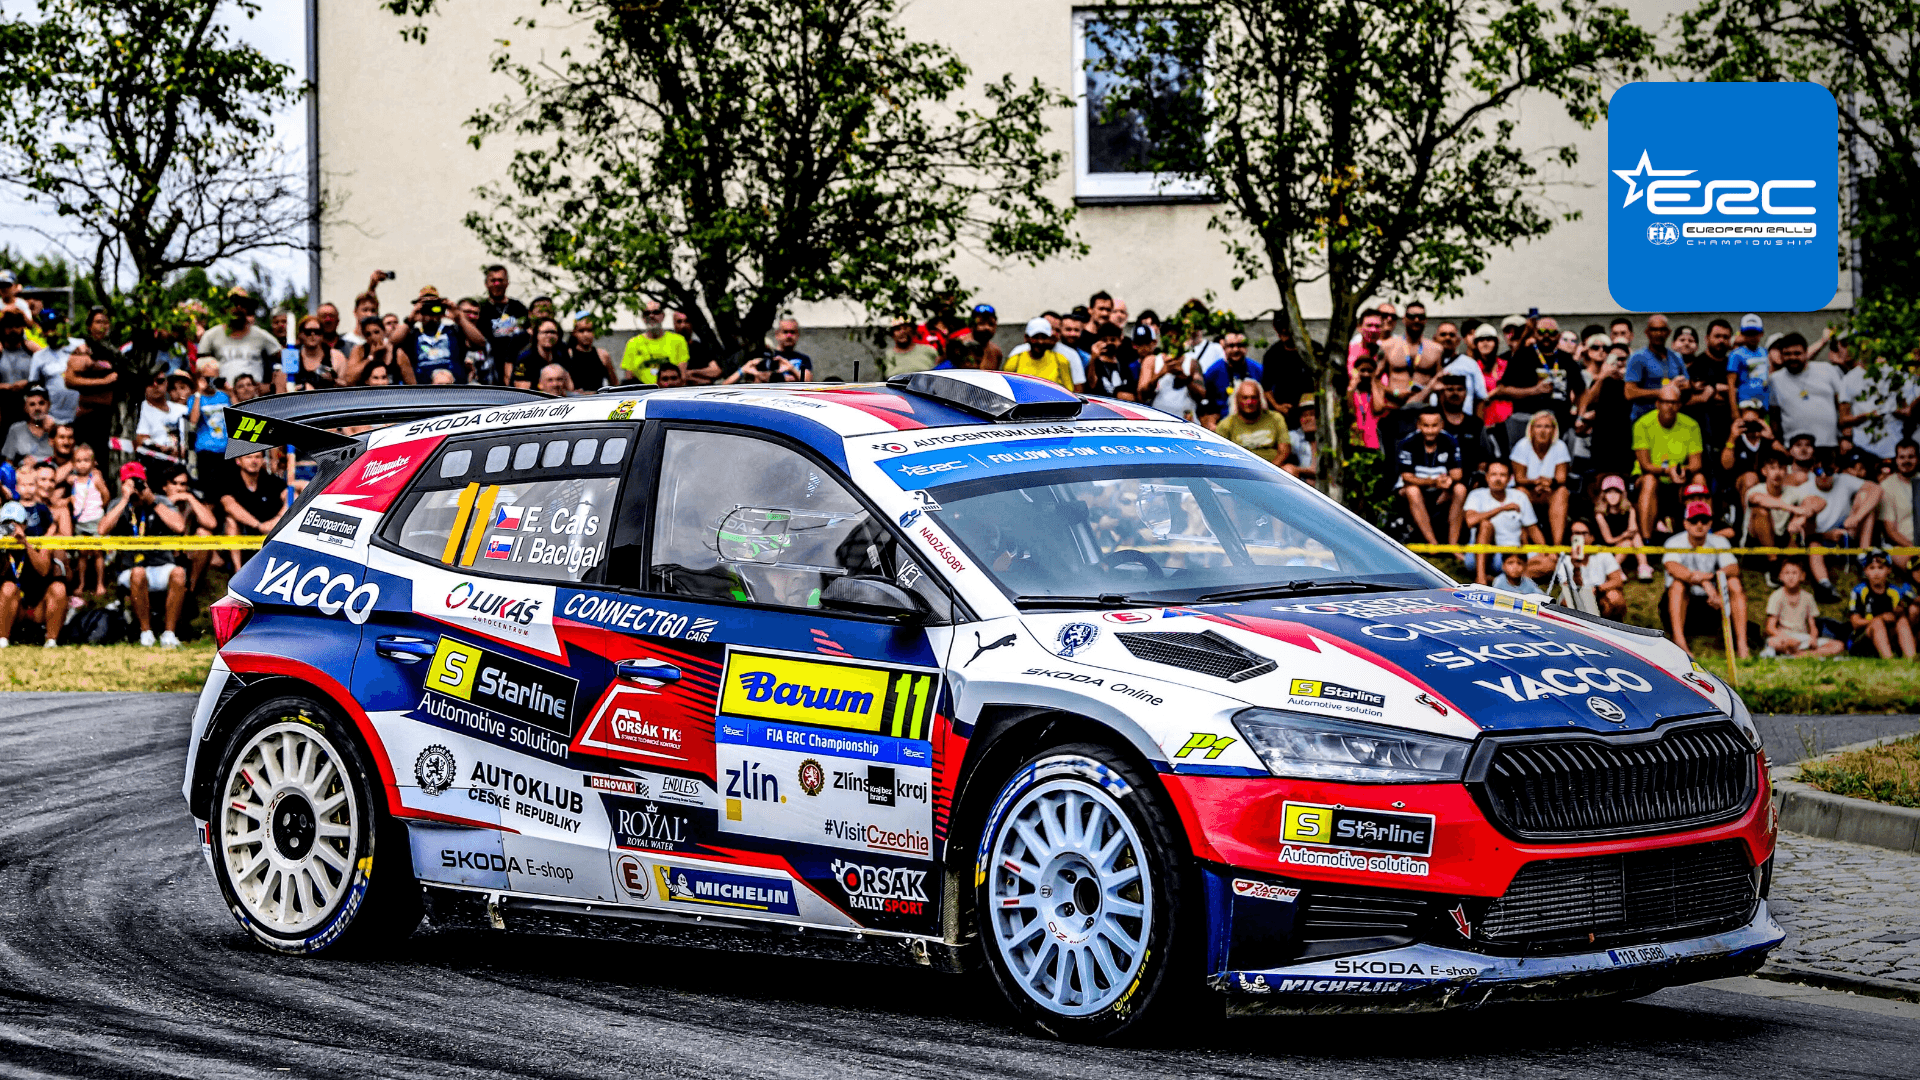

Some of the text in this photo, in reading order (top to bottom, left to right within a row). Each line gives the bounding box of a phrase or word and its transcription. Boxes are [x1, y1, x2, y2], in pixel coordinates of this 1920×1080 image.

[485, 405, 549, 425] Originální
[549, 403, 575, 419] díly
[233, 416, 267, 443] P1
[913, 429, 1022, 448] AUTOCENTRUM
[1137, 426, 1178, 436] TEAM
[361, 455, 411, 481] Milwaukee
[987, 450, 1051, 464] FOLLOW
[1052, 448, 1076, 458] US
[1076, 446, 1099, 456] ON
[312, 514, 357, 535] Europartner
[441, 481, 500, 567] 11
[522, 507, 543, 533] E.
[515, 538, 528, 562] I.
[919, 526, 966, 574] NADZÁSOBY
[254, 556, 380, 625] YACCO
[467, 589, 544, 625] LUKÁŠ
[563, 593, 689, 639] CONNECT60
[472, 614, 529, 637] AUTOCENTRUM
[685, 628, 710, 644] CAIS
[478, 667, 568, 720] Starline
[740, 671, 874, 715] Barum
[1110, 683, 1164, 706] Online
[1323, 686, 1382, 704] Starline
[1472, 667, 1653, 702] YACCO
[890, 673, 931, 740] 11
[1287, 697, 1383, 718] Automotive solution
[417, 692, 570, 760] Automotive solution
[617, 719, 659, 738] ORSÁK
[766, 728, 781, 743] FIA
[786, 730, 805, 746] ERC
[808, 733, 879, 757] Championship
[1174, 732, 1237, 759] P1
[470, 761, 584, 815] AUTOKLUB
[593, 777, 634, 792] RENOVAK
[662, 776, 700, 794] ENDLESS
[881, 786, 893, 795] bez
[896, 778, 927, 804] kraj
[467, 784, 510, 811] ČESKÉ
[515, 802, 581, 834] REPUBLIKY
[617, 808, 686, 843] ROYAL
[825, 819, 929, 851] #VisitCzechia
[1336, 819, 1425, 844] Starline
[627, 836, 674, 851] ROYAL WATER
[526, 858, 574, 884] E-shop
[1281, 847, 1427, 874] Automotive solution
[622, 862, 643, 890] E
[695, 880, 789, 905] MICHELIN
[1254, 883, 1298, 897] RACING
[1618, 947, 1665, 965] 11R 0588
[1430, 965, 1478, 977] E-shop
